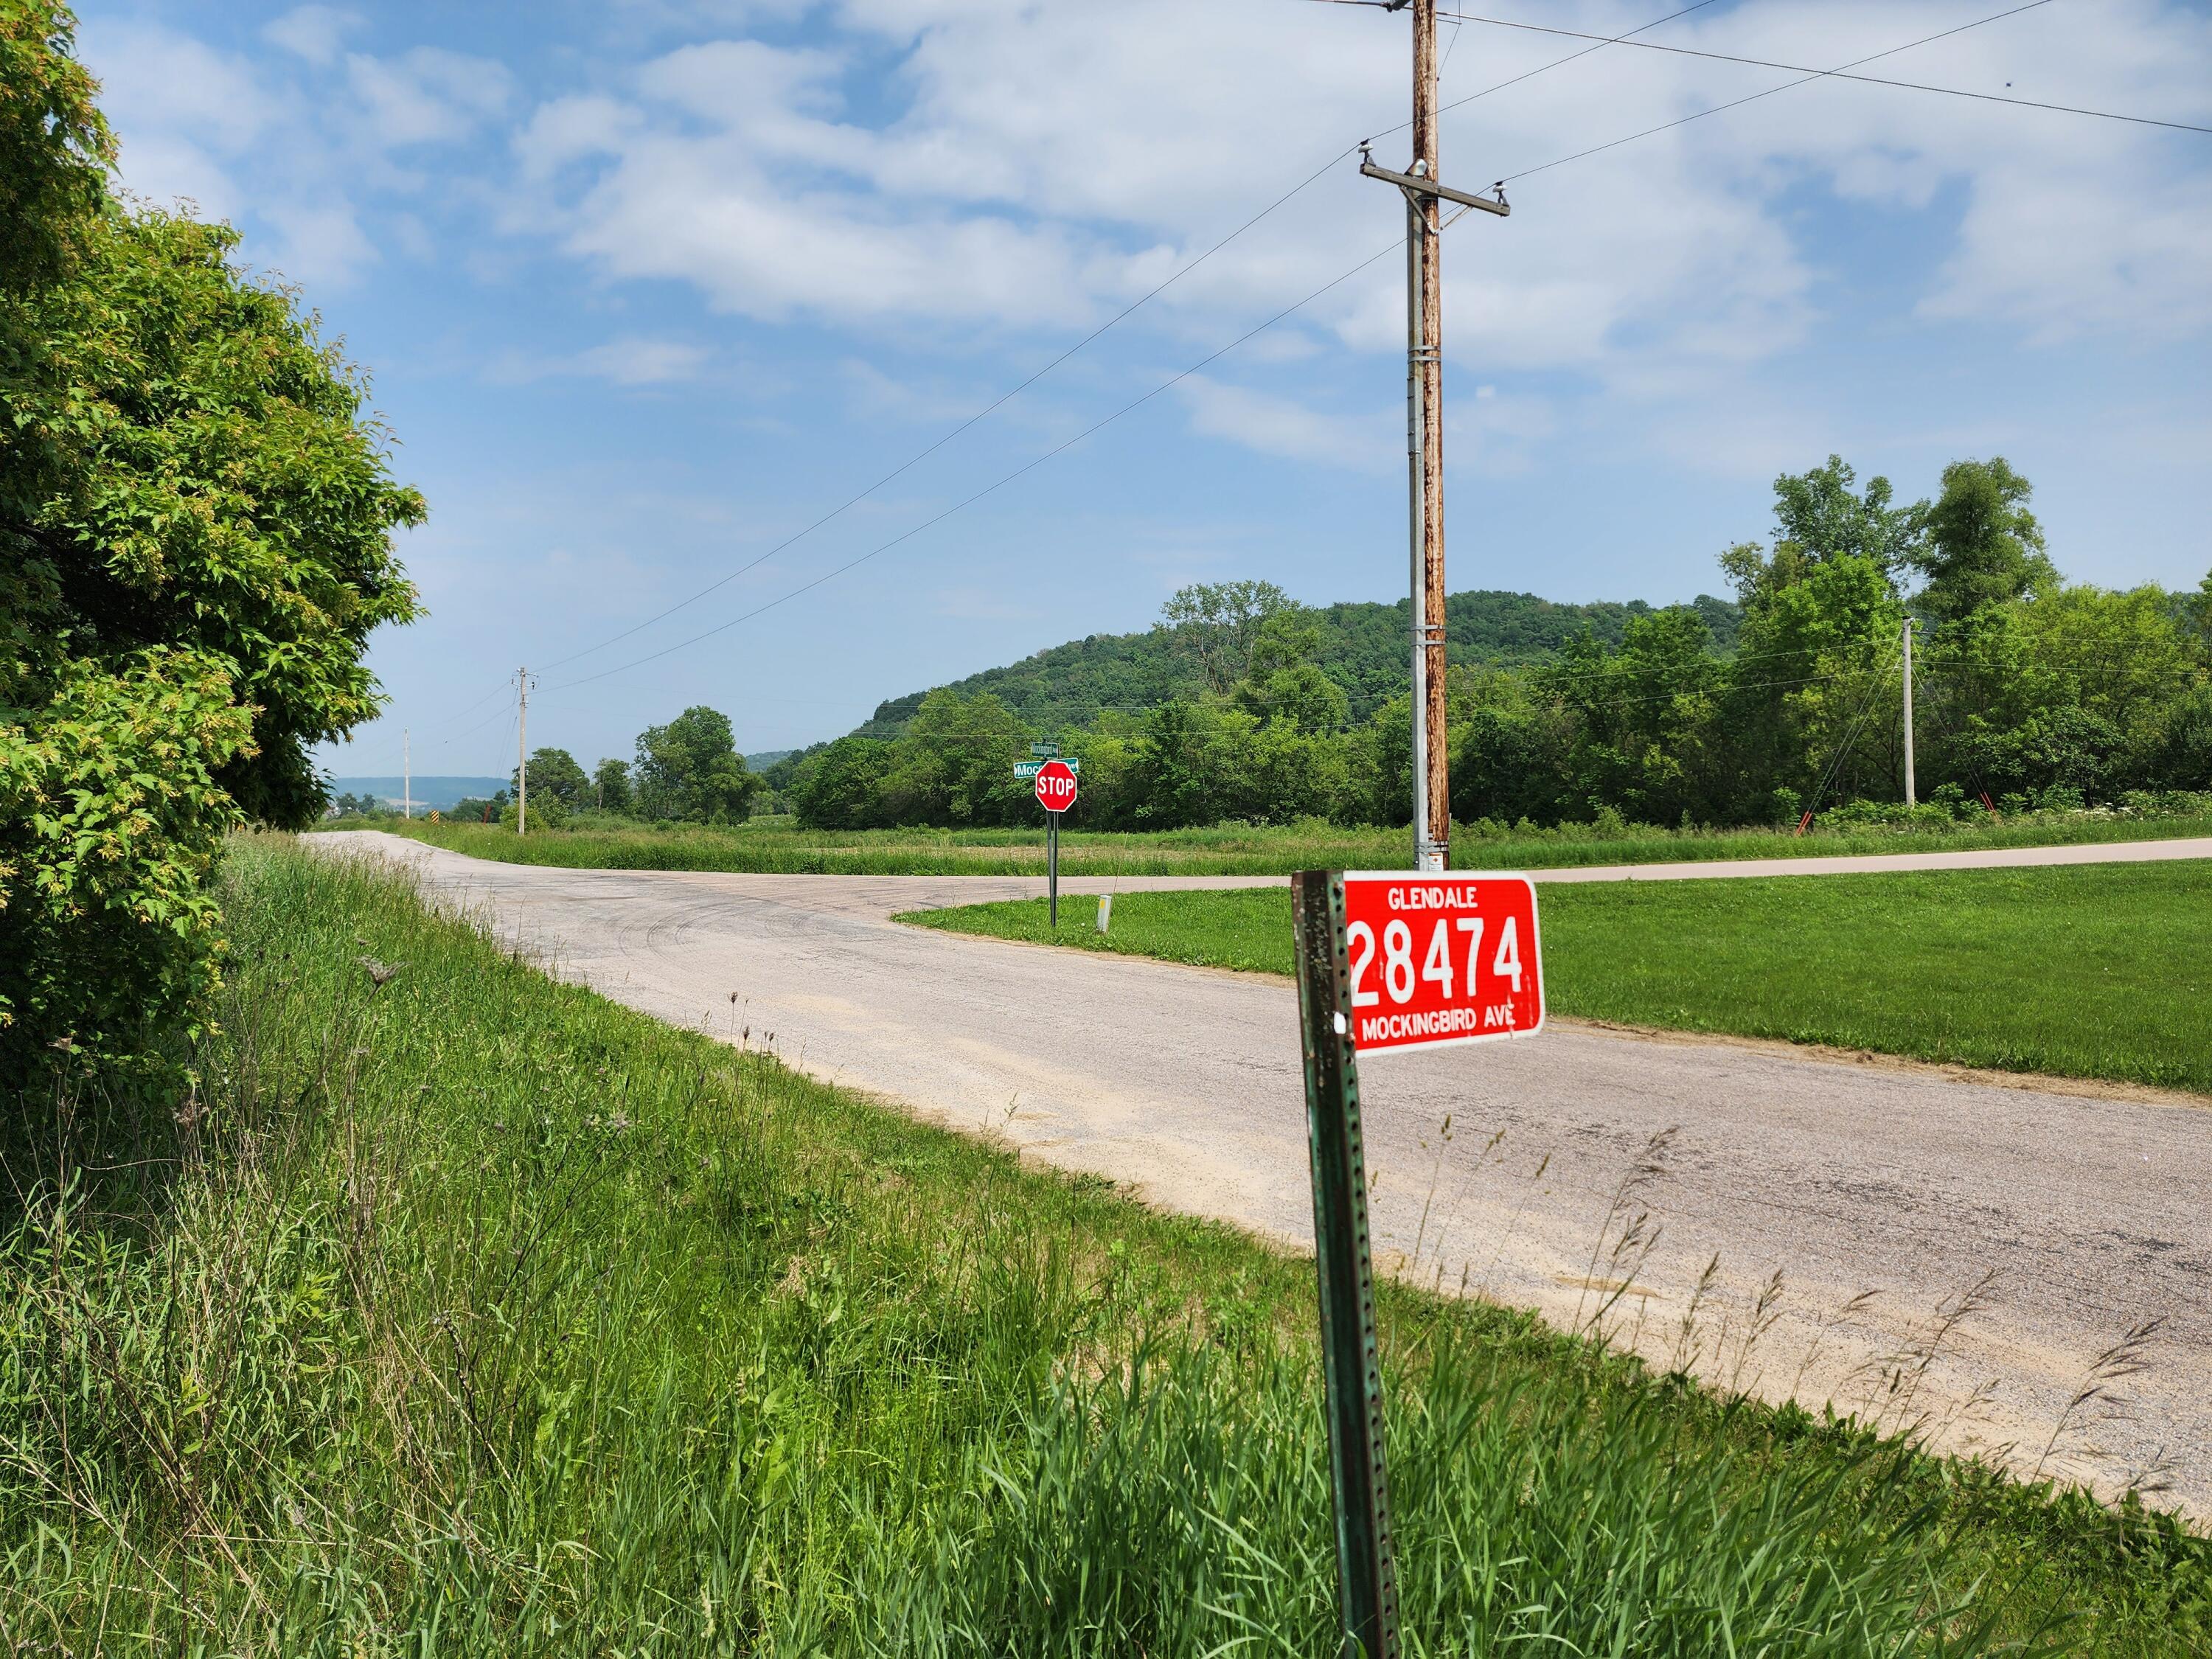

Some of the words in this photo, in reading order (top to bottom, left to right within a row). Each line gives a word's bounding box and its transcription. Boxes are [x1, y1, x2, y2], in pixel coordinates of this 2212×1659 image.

[1038, 776, 1074, 796] STOP
[1388, 886, 1478, 911] GLENDALE
[1346, 916, 1522, 1007] 28474
[1361, 1008, 1477, 1042] MOCKINGBIRD
[1484, 1004, 1516, 1027] AVE
